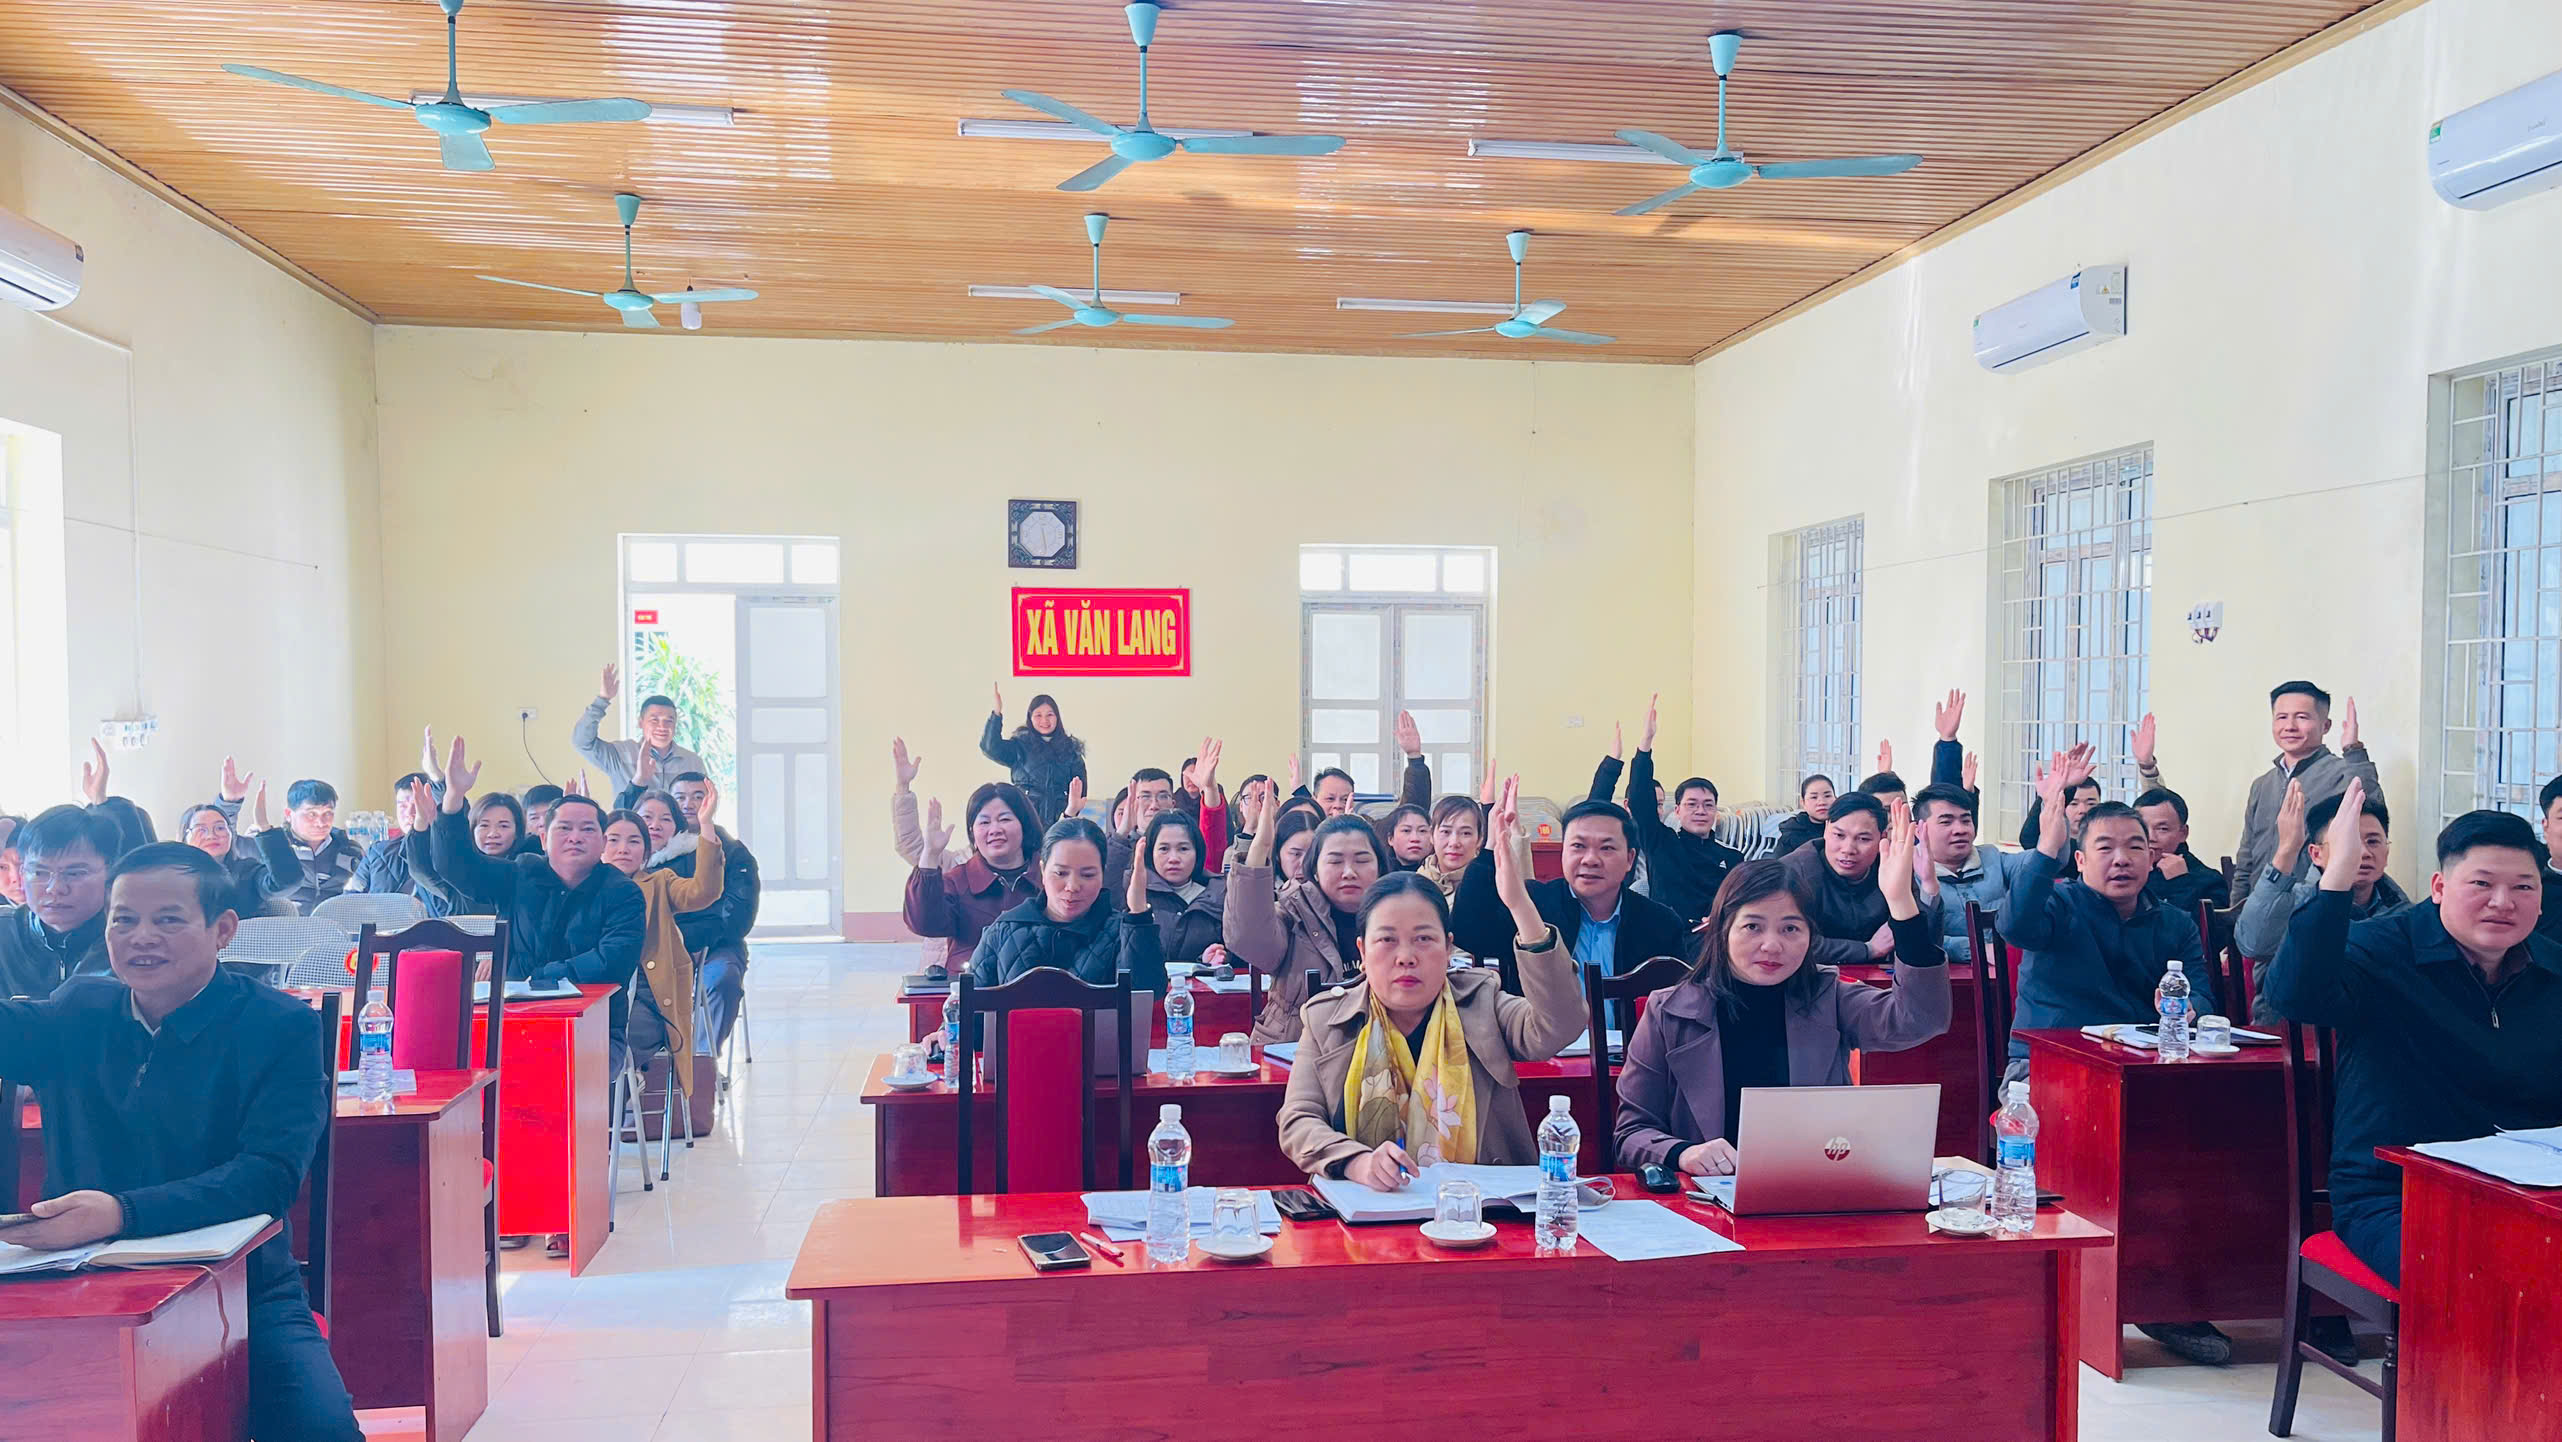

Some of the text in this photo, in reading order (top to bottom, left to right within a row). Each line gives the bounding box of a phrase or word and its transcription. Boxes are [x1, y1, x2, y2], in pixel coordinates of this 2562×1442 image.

[1026, 599, 1177, 656] XÃ VĂN LANG
[1826, 1137, 1850, 1161] hp
